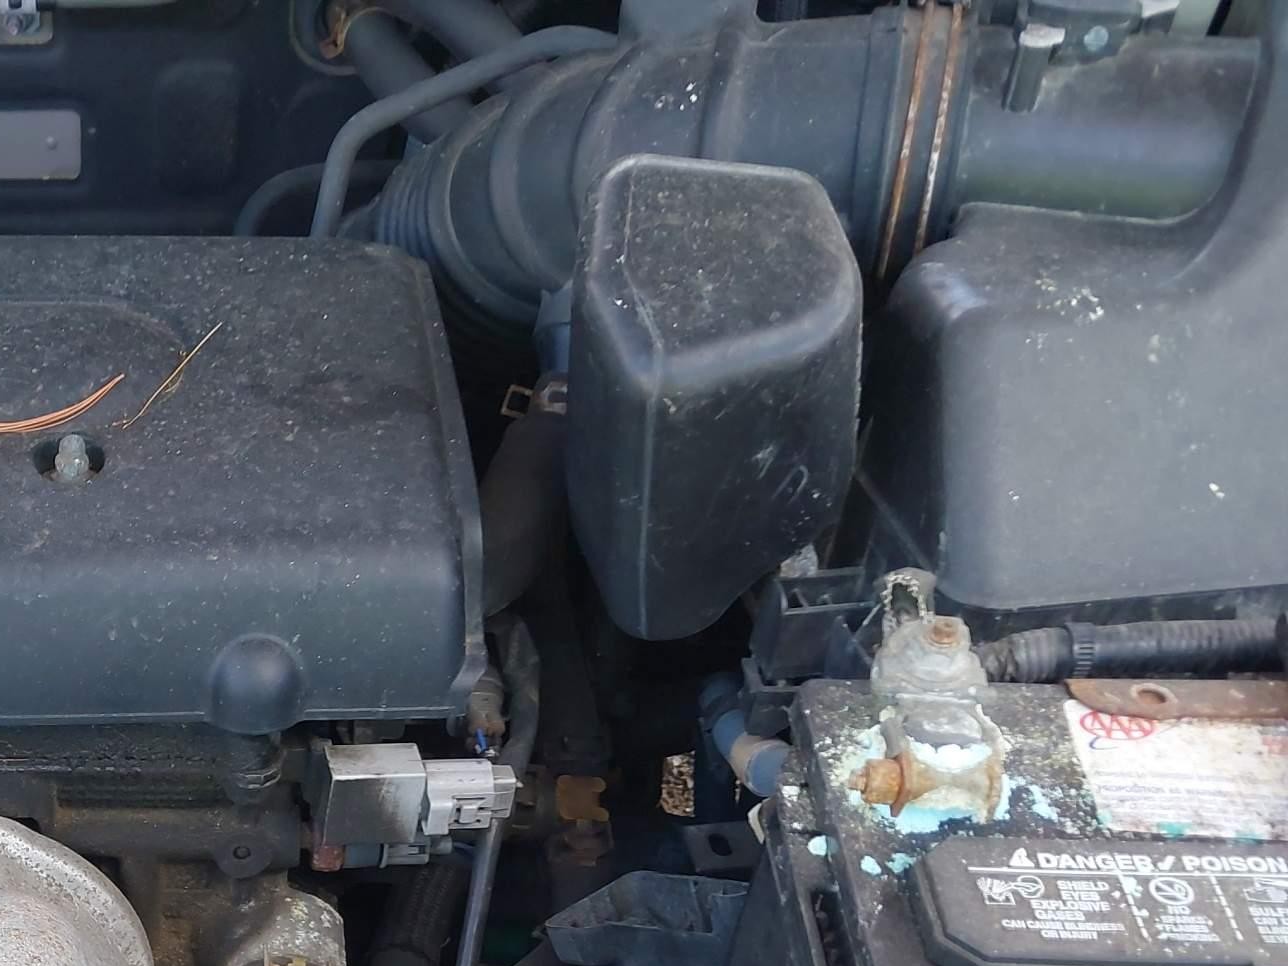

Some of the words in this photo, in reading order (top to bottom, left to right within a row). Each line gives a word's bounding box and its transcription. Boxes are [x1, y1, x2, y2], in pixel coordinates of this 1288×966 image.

[1087, 710, 1155, 740] AAA
[1036, 852, 1155, 872] DANGER
[1180, 855, 1288, 873] POISON
[1056, 880, 1110, 891] SHIELD
[1060, 890, 1101, 901] EYES
[1030, 899, 1111, 912] EXPLOSIVE
[1033, 909, 1086, 920] GASES
